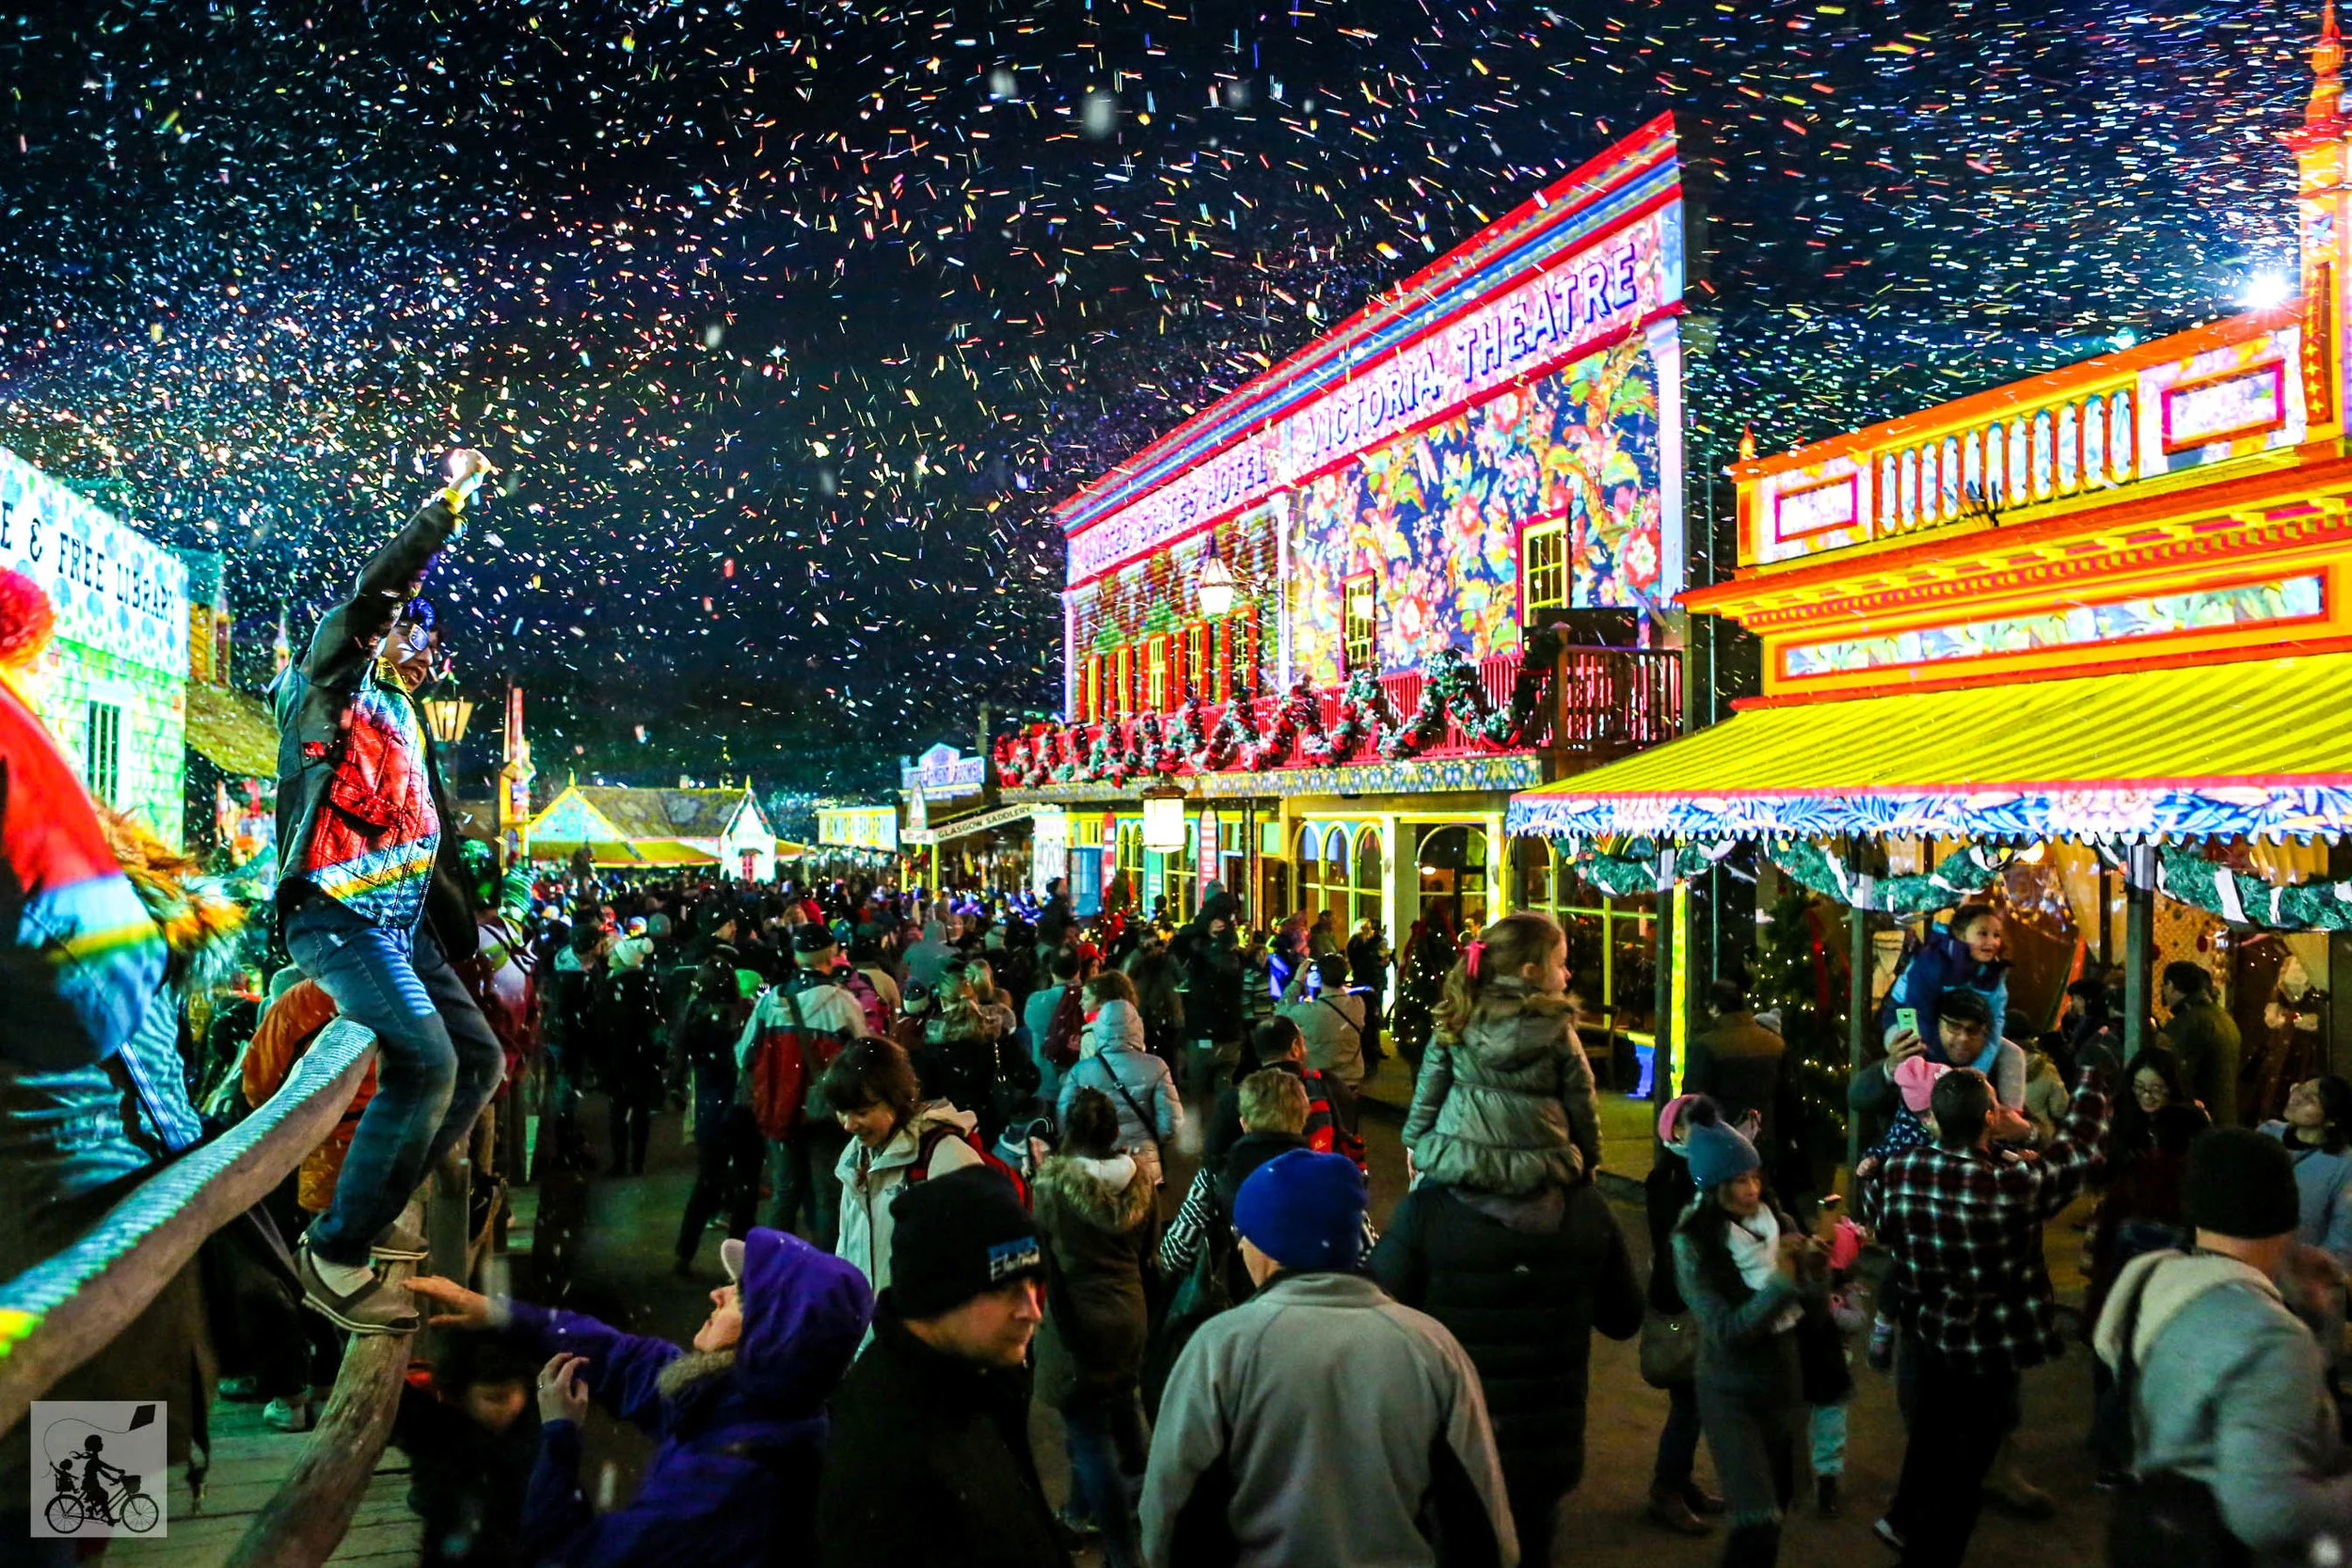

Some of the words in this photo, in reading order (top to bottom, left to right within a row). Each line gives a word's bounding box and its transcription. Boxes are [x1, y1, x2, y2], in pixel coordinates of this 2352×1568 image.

[1306, 351, 1441, 457] VICTORIA
[1457, 244, 1638, 384] THEATRE
[1206, 443, 1268, 510] HOTEL
[29, 517, 44, 562] &
[57, 532, 105, 594] FREE
[117, 562, 176, 626] LIBRARY
[938, 818, 983, 839] GLASGOW
[985, 805, 1031, 825] SADDLERY
